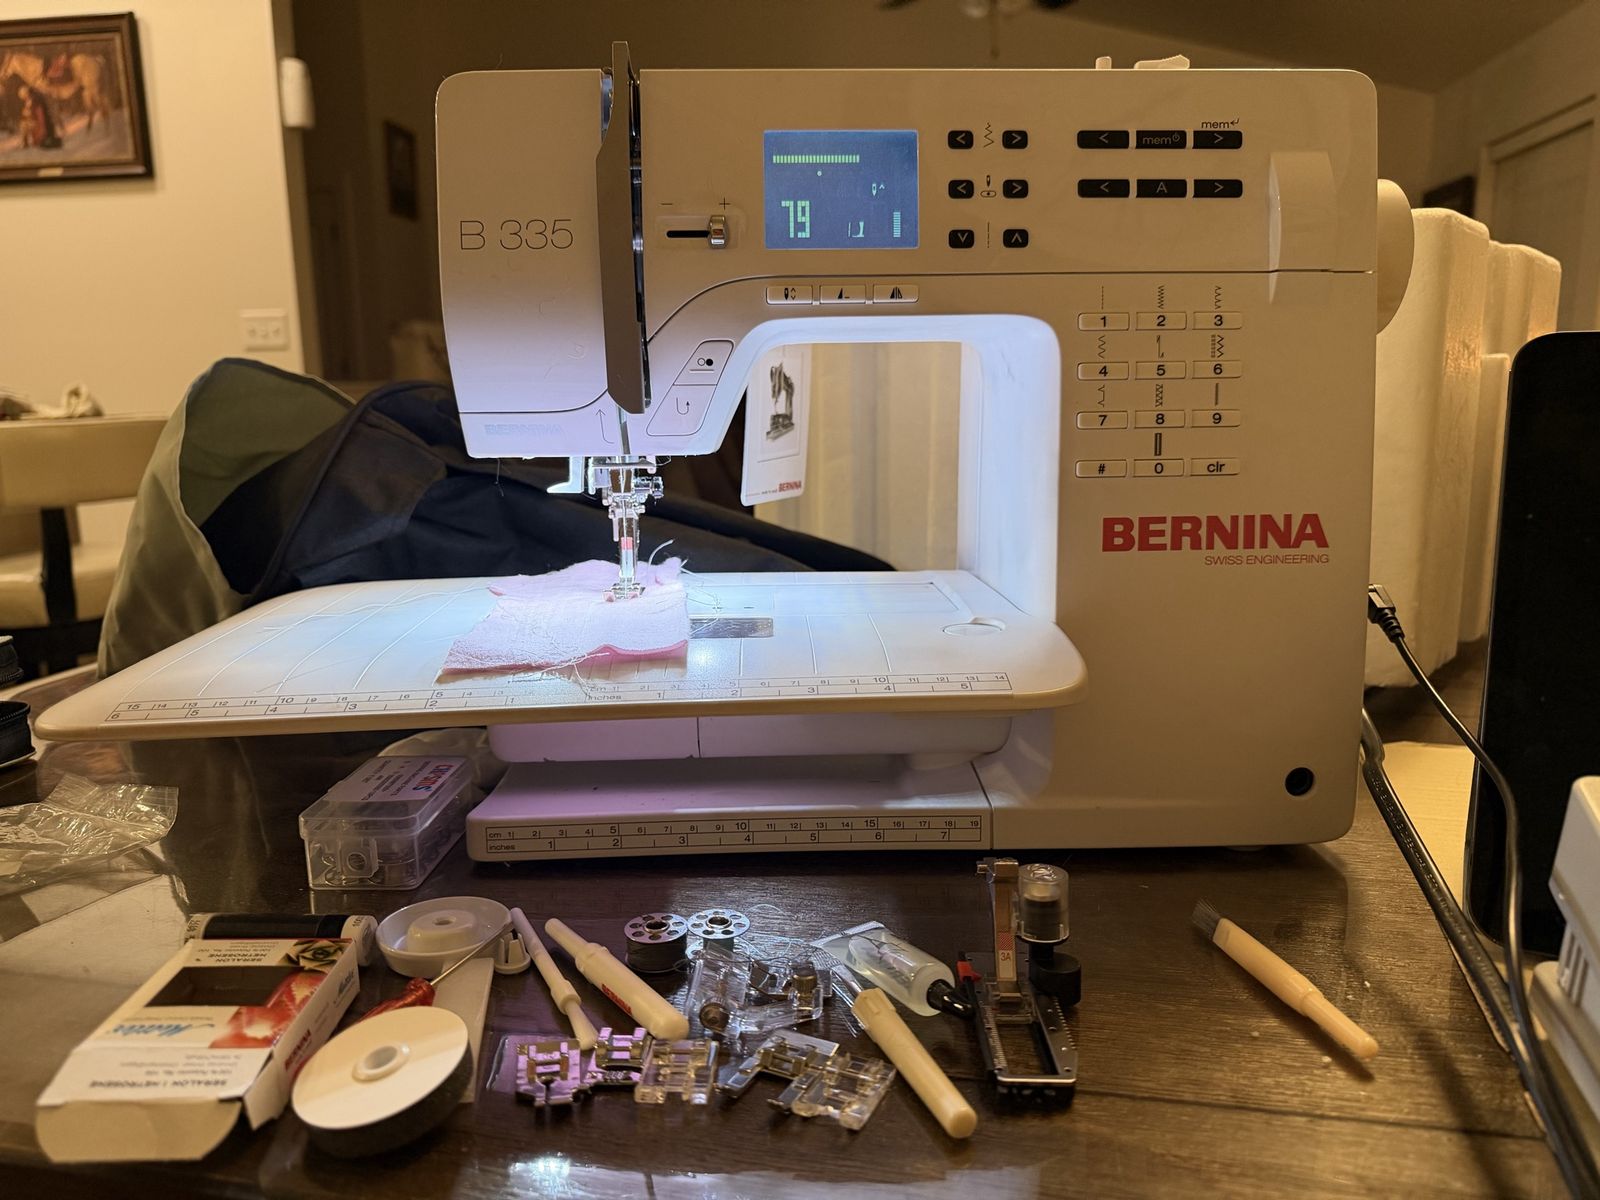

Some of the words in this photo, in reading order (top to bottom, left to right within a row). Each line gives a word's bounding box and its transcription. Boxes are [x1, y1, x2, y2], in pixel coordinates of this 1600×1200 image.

[1200, 120, 1230, 130] mem
[1142, 136, 1172, 145] mem
[1156, 181, 1168, 194] A
[780, 200, 810, 238] 79
[460, 220, 486, 250] B
[499, 218, 574, 250] 335
[1100, 316, 1106, 327] 1
[1156, 315, 1166, 327] 2
[1214, 314, 1223, 326] 3
[1098, 365, 1108, 377] 4
[1156, 364, 1166, 376] 5
[1213, 363, 1223, 375] 6
[1098, 414, 1107, 426] 7
[1156, 413, 1165, 424] 8
[1212, 413, 1222, 424] 9
[1154, 462, 1164, 474] 0
[1206, 462, 1226, 472] clr
[1102, 513, 1330, 552] BERNINA
[1204, 554, 1243, 566] SWISS
[1246, 553, 1330, 565] ENGINEERING
[609, 825, 617, 834] 5
[735, 822, 748, 830] 10
[864, 819, 876, 828] 15
[489, 842, 515, 851] inches
[612, 838, 620, 847] 2
[678, 836, 686, 845] 3
[744, 834, 751, 842] 4
[810, 832, 817, 841] 5
[875, 832, 882, 840] 6
[940, 831, 947, 840] 7
[1000, 952, 1012, 961] 3A
